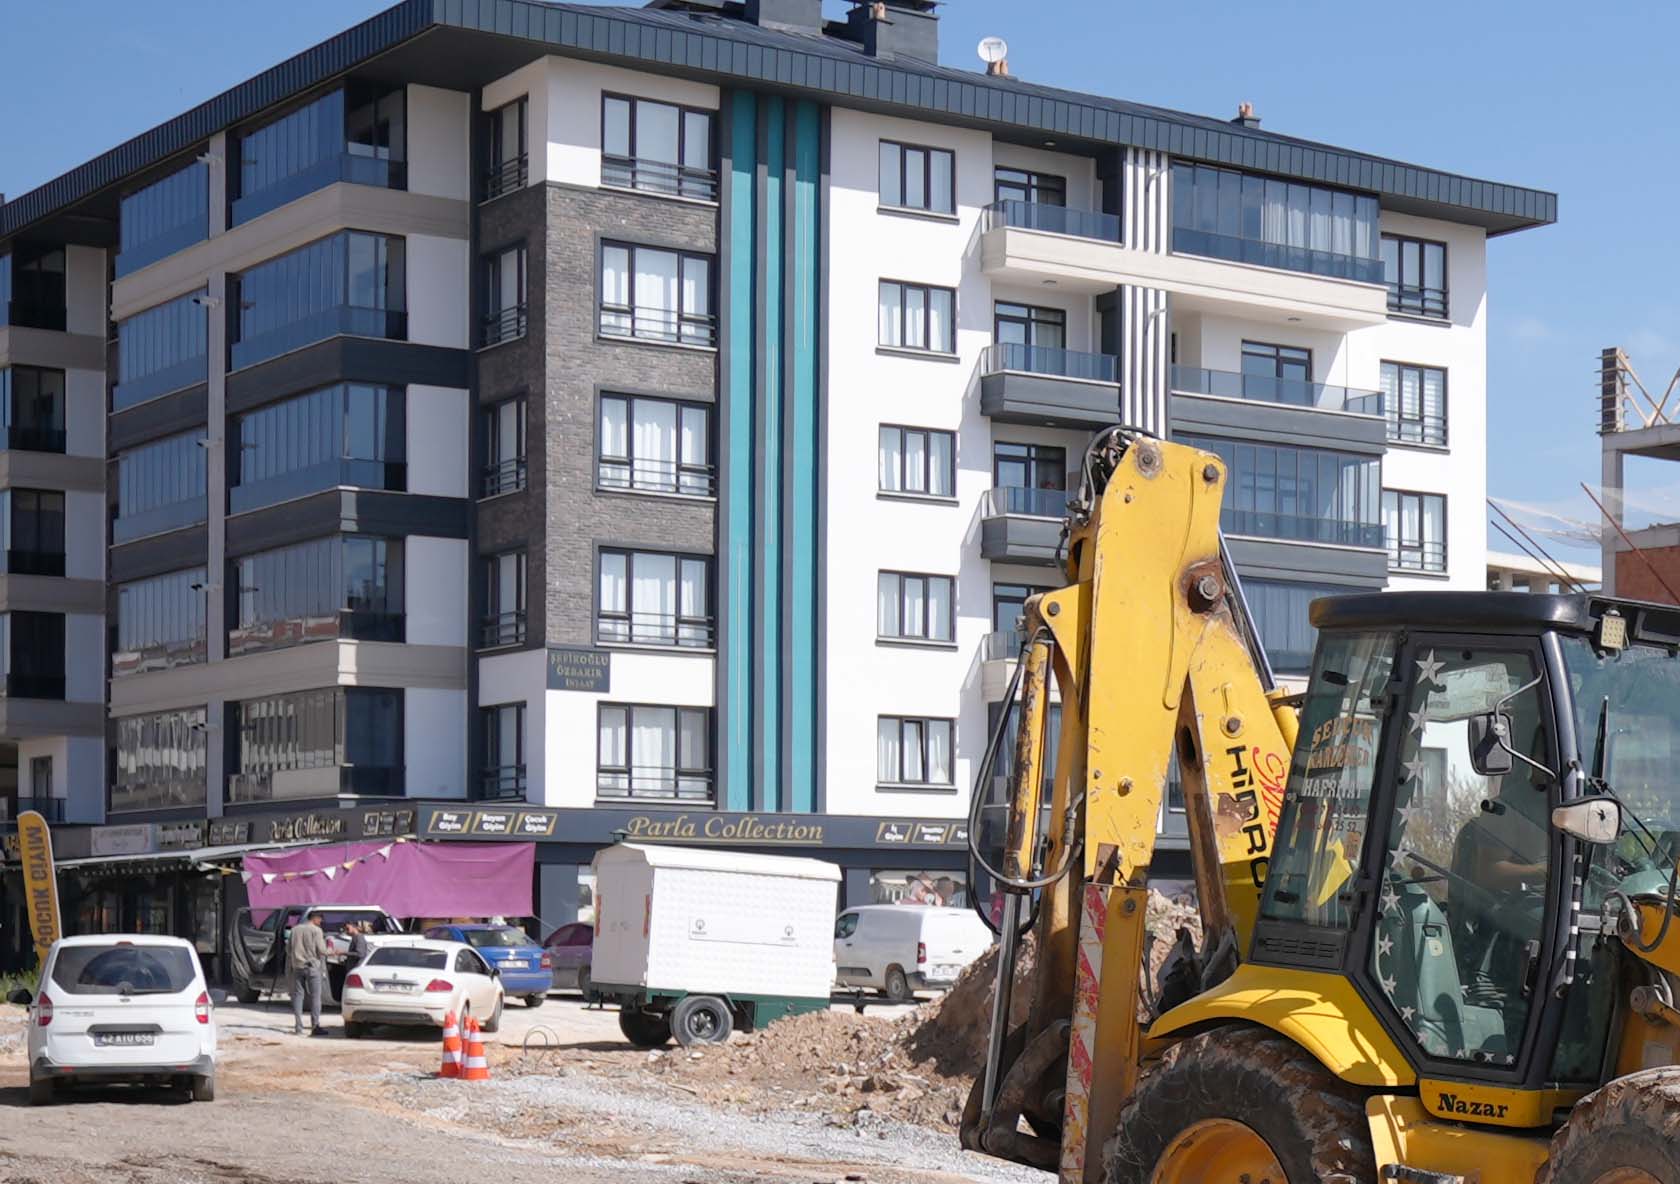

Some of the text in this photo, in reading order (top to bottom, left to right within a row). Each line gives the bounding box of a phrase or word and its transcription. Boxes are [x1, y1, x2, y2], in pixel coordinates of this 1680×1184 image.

[627, 815, 824, 840] Parla Collection
[1437, 1092, 1509, 1118] Nazar
